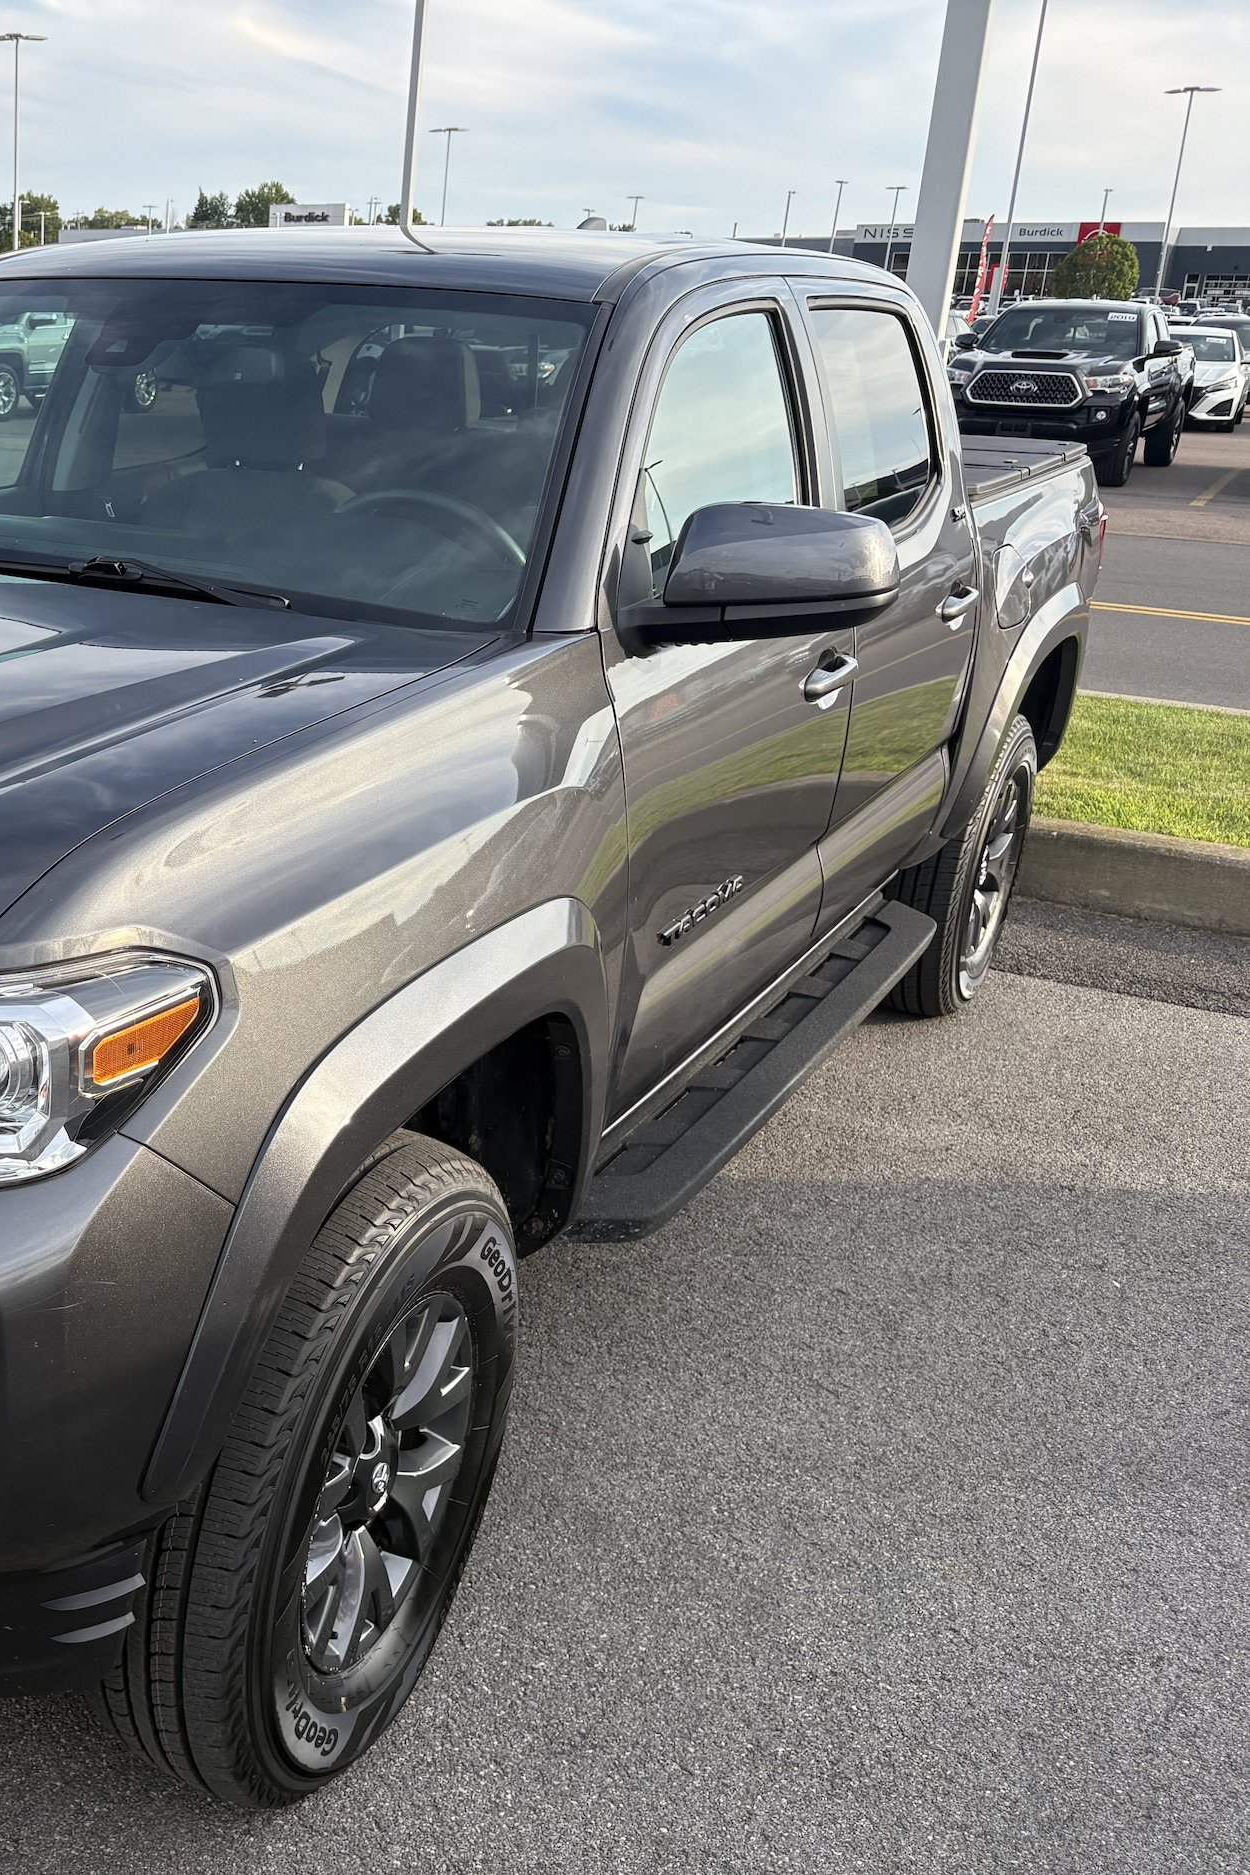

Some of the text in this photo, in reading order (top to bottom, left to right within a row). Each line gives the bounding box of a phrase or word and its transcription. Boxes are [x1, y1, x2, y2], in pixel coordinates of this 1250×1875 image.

[284, 211, 330, 223] Burdick
[863, 228, 915, 239] NISS
[1019, 227, 1064, 237] Burdick
[656, 873, 743, 946] TACOMA
